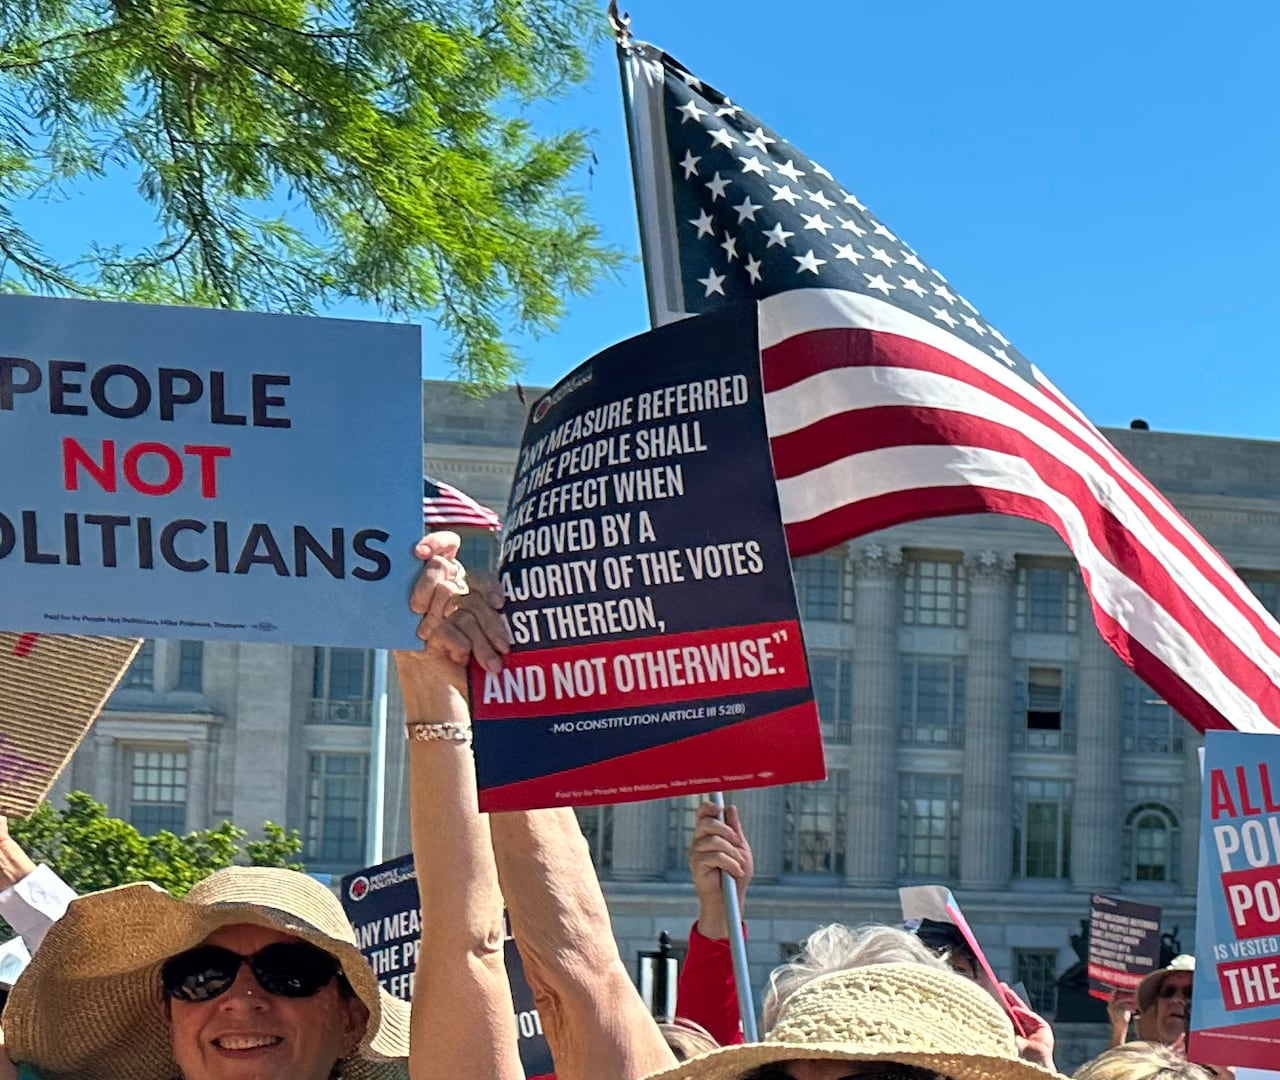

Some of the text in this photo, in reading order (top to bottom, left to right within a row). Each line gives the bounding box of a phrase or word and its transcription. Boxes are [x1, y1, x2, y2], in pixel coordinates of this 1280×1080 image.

[0, 357, 291, 428] PEOPLE
[62, 437, 231, 498] NOT
[483, 666, 547, 705] AND
[552, 658, 608, 700] NOT
[575, 713, 660, 732] CONSTITUTION
[660, 708, 705, 722] ARTICLE
